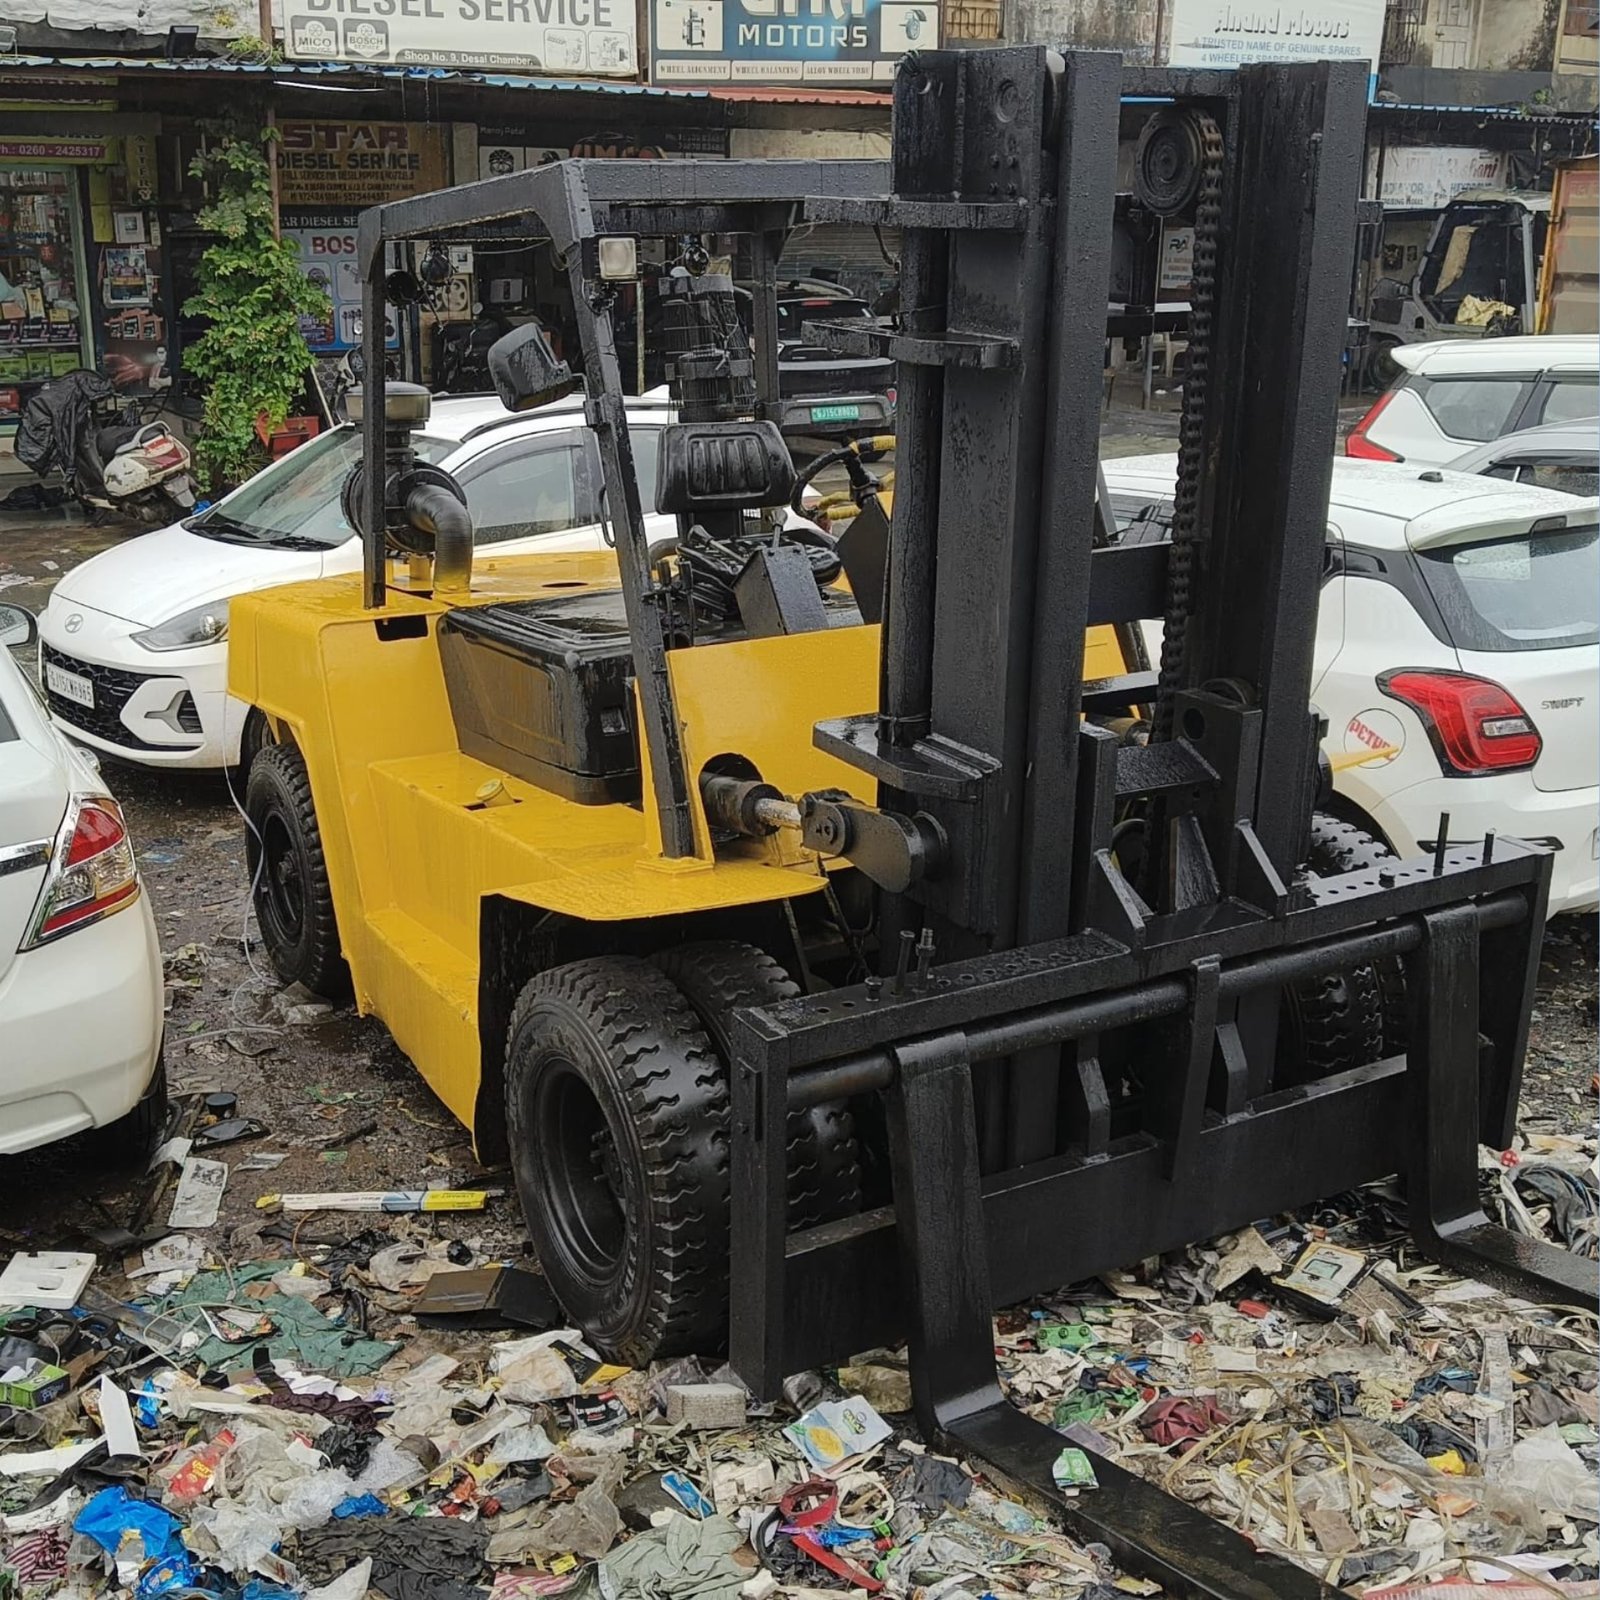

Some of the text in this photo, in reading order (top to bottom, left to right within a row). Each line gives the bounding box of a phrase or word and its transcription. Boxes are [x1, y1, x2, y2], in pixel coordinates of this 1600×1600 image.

[458, 0, 612, 27] SERVICE
[298, 36, 332, 47] MICO
[349, 36, 383, 46] BOSCH
[738, 23, 868, 47] MOTORS
[1201, 36, 1244, 50] TRUSTED
[1245, 40, 1272, 51] NAME
[1274, 42, 1286, 51] OF
[1287, 43, 1326, 54] GENUINE
[1328, 45, 1362, 56] SPARES
[404, 50, 430, 61] Shop
[431, 52, 448, 61] No.
[1208, 53, 1253, 63] WHEELER
[283, 124, 408, 149] STAR
[19, 145, 46, 155] 0260
[55, 146, 101, 157] 2425317
[276, 153, 420, 170] DIESEL SERVICE
[300, 216, 341, 227] DIESEL
[312, 235, 356, 255] BOS
